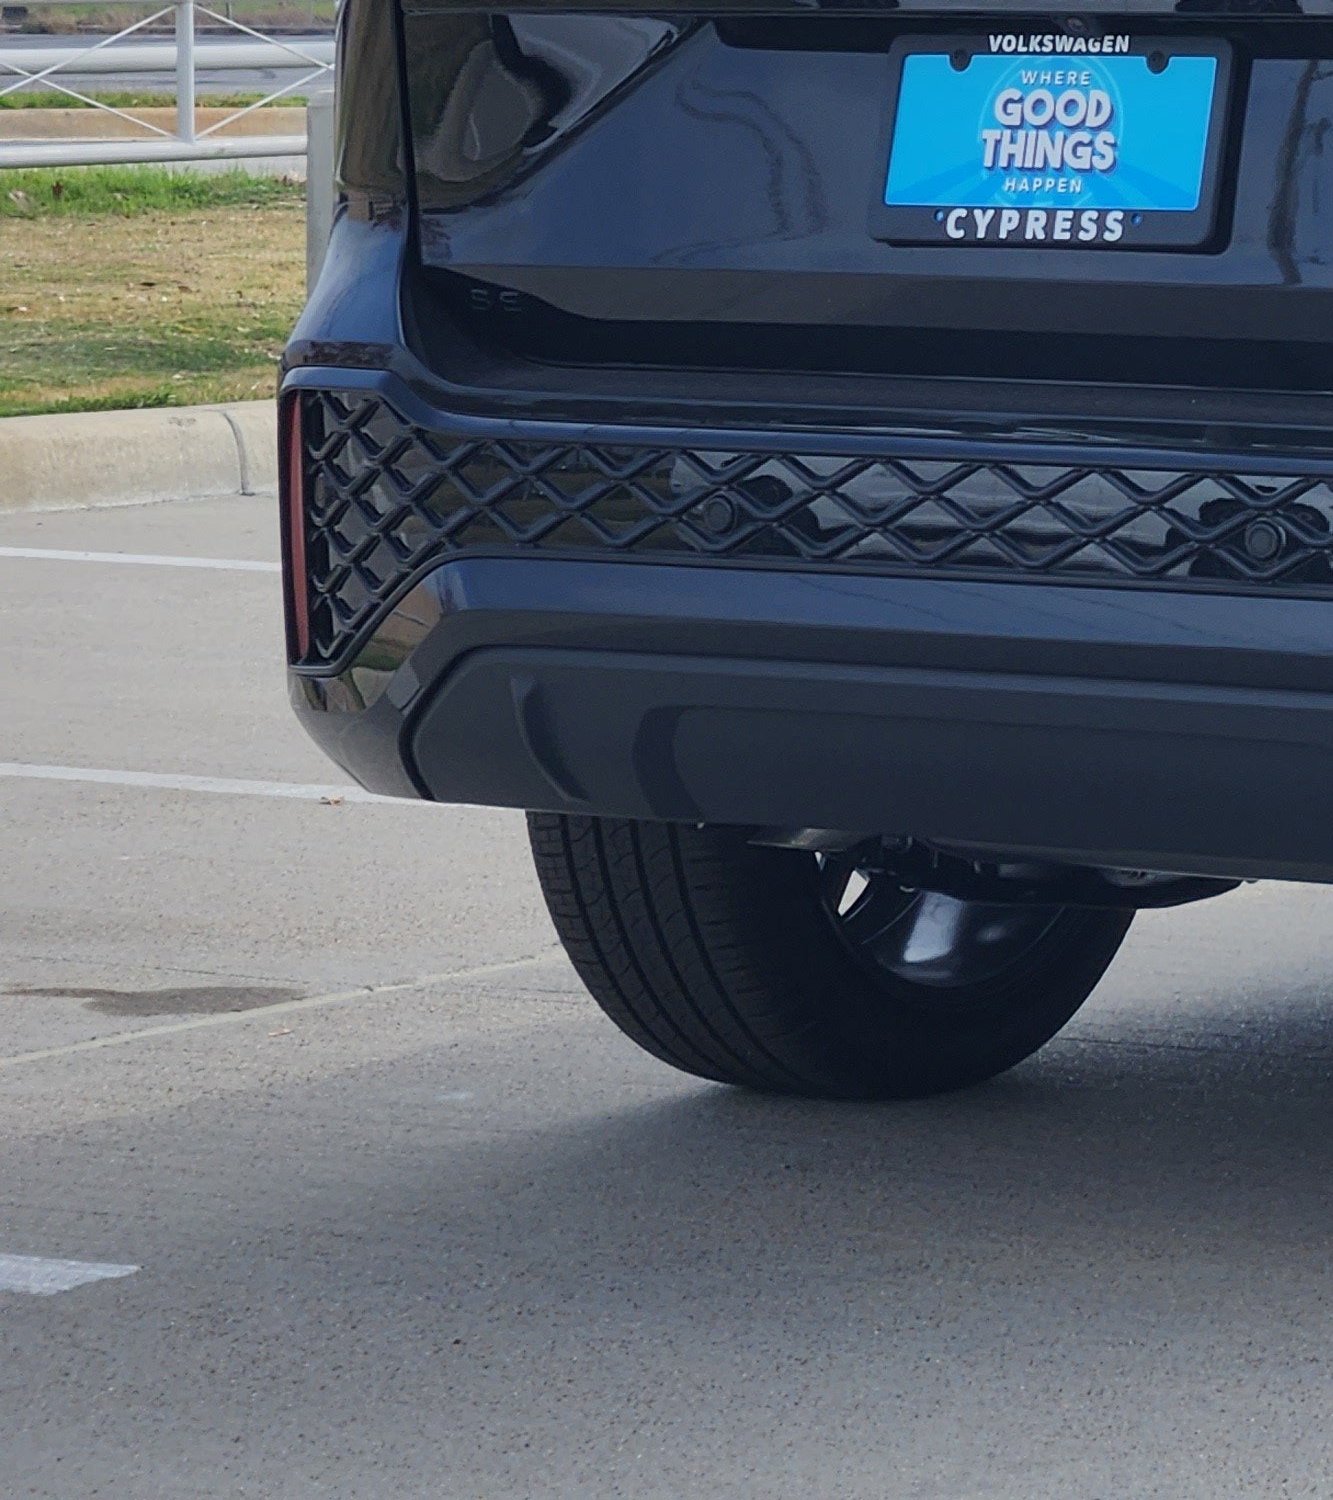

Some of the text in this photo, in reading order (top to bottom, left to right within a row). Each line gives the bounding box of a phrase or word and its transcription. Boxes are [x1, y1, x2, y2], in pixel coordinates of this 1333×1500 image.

[988, 34, 1131, 54] VOLKSWAGEN
[1020, 70, 1091, 86] WHERE
[994, 87, 1113, 129] GOOD
[981, 129, 1118, 172] THINGS
[1003, 177, 1083, 194] HAPPEN
[945, 207, 1125, 242] CYPRESS
